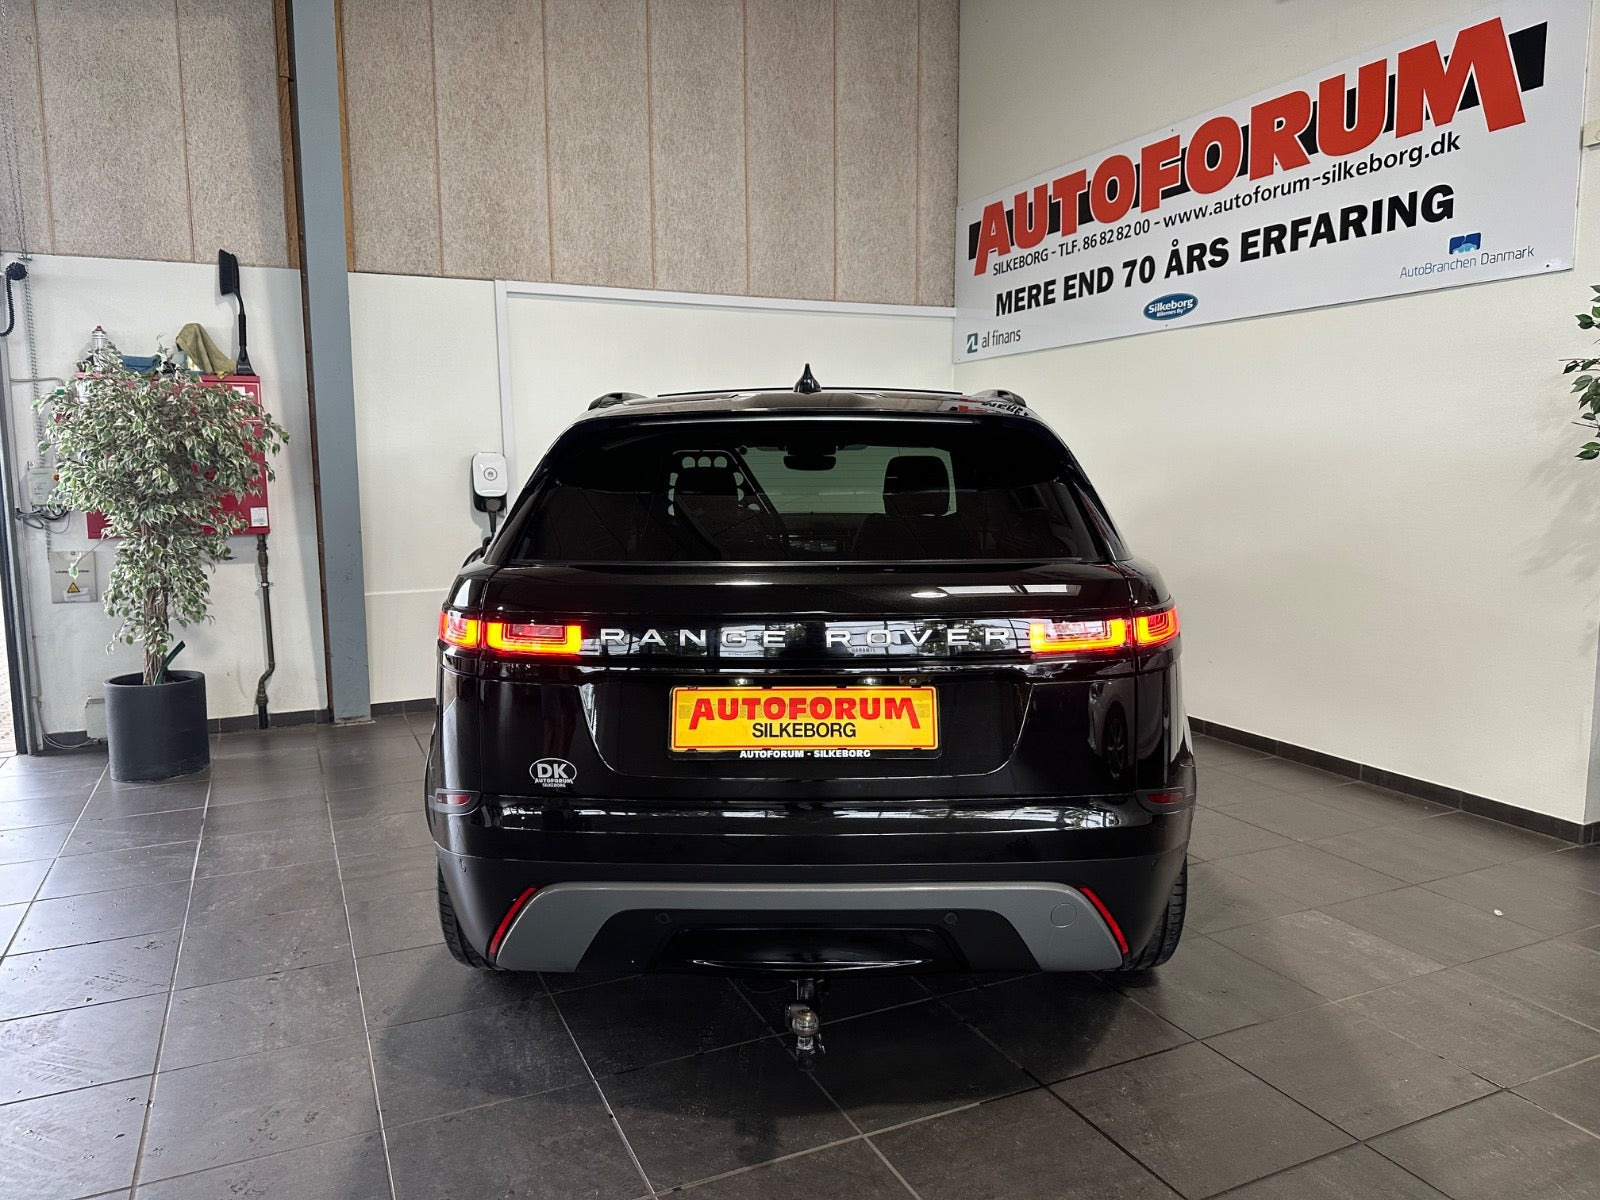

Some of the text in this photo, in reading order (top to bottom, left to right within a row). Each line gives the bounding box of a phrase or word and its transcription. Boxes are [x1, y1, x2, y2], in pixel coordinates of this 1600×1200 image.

[974, 16, 1526, 276] AUTOFORUM
[993, 248, 1049, 276] SILKEBORG
[1058, 239, 1081, 257] TLF.
[1163, 131, 1461, 228] www.autoforum-silkeborg.dk
[995, 184, 1455, 317] MERE END 70 ÅRS ERFARING
[1400, 245, 1535, 279] AutoBranchen Danmark
[1148, 298, 1194, 314] Silkeborg
[981, 329, 1021, 348] al finans
[600, 628, 1010, 648] RANGE ROVER
[689, 696, 921, 730] AUTOFORUM
[752, 722, 857, 738] SILKEBORG
[739, 750, 804, 759] AUTOFORUM
[814, 749, 871, 758] SILKEBORG
[537, 763, 569, 779] DK
